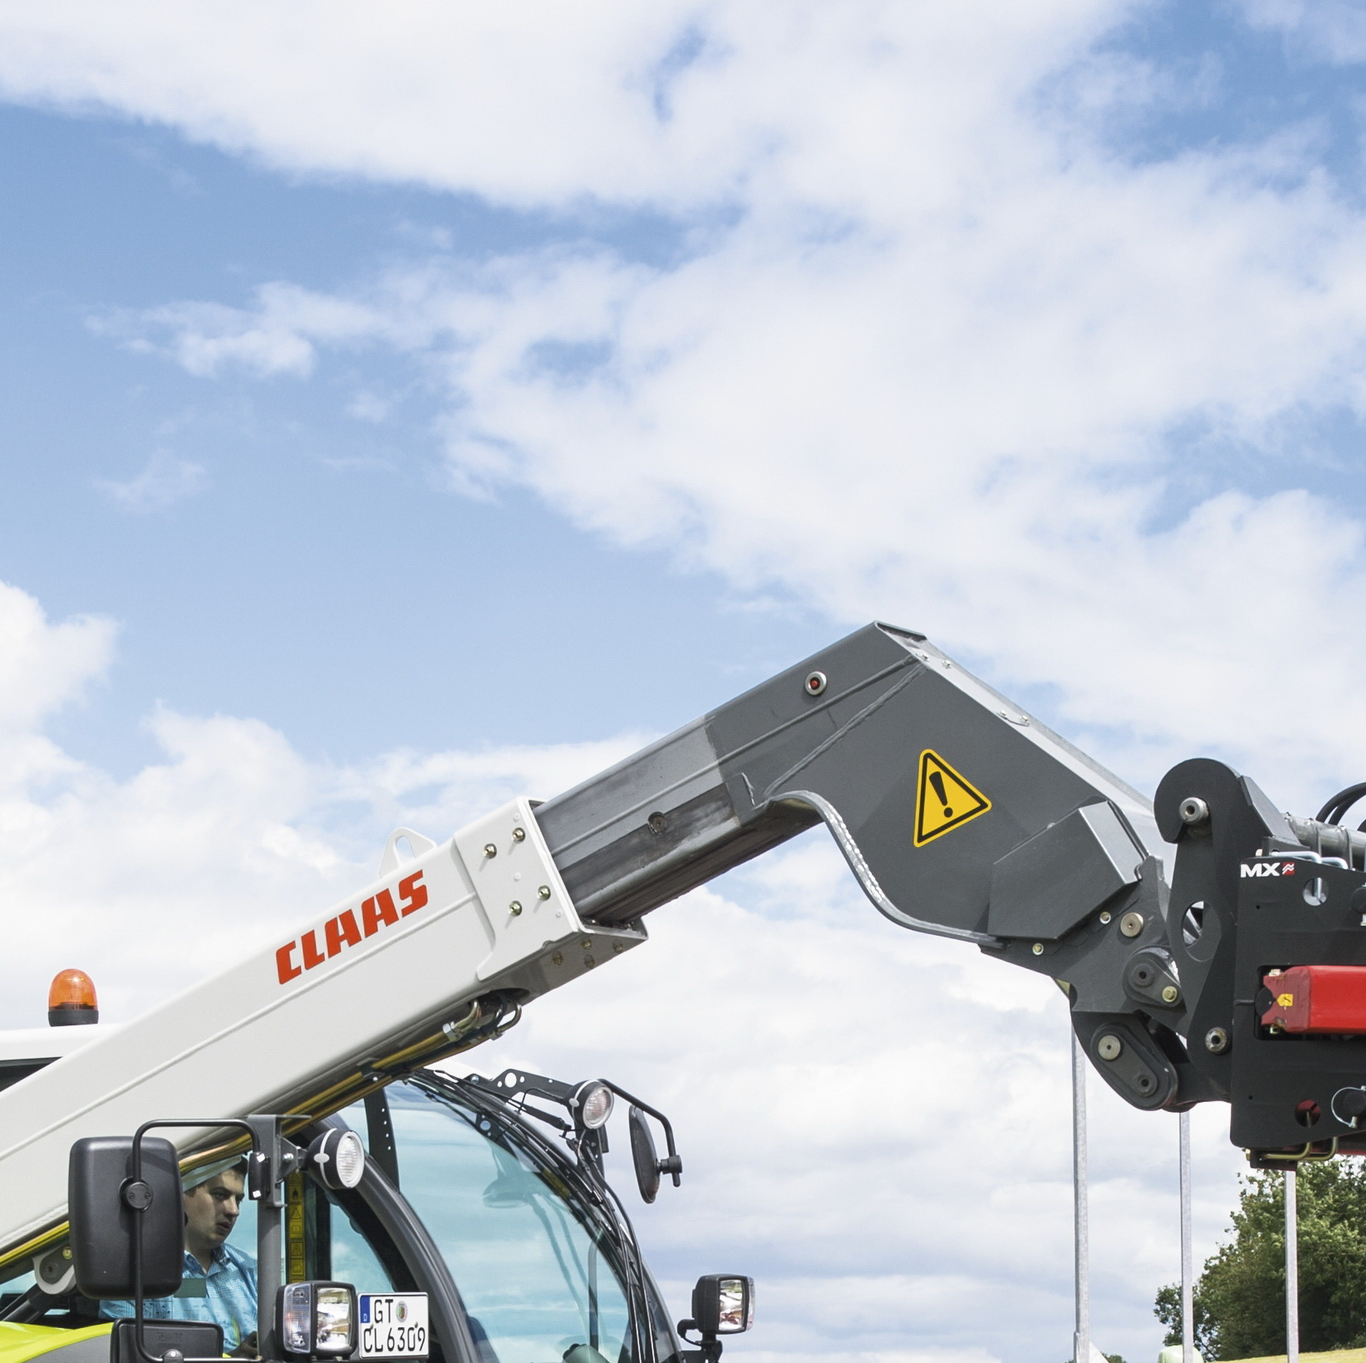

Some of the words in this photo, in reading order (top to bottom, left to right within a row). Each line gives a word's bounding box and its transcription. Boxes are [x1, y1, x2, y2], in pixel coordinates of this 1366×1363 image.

[1240, 862, 1281, 878] MX
[276, 869, 429, 985] CLAAS
[374, 1298, 394, 1324] GT
[363, 1326, 384, 1353] CL
[387, 1326, 426, 1352] 6309
